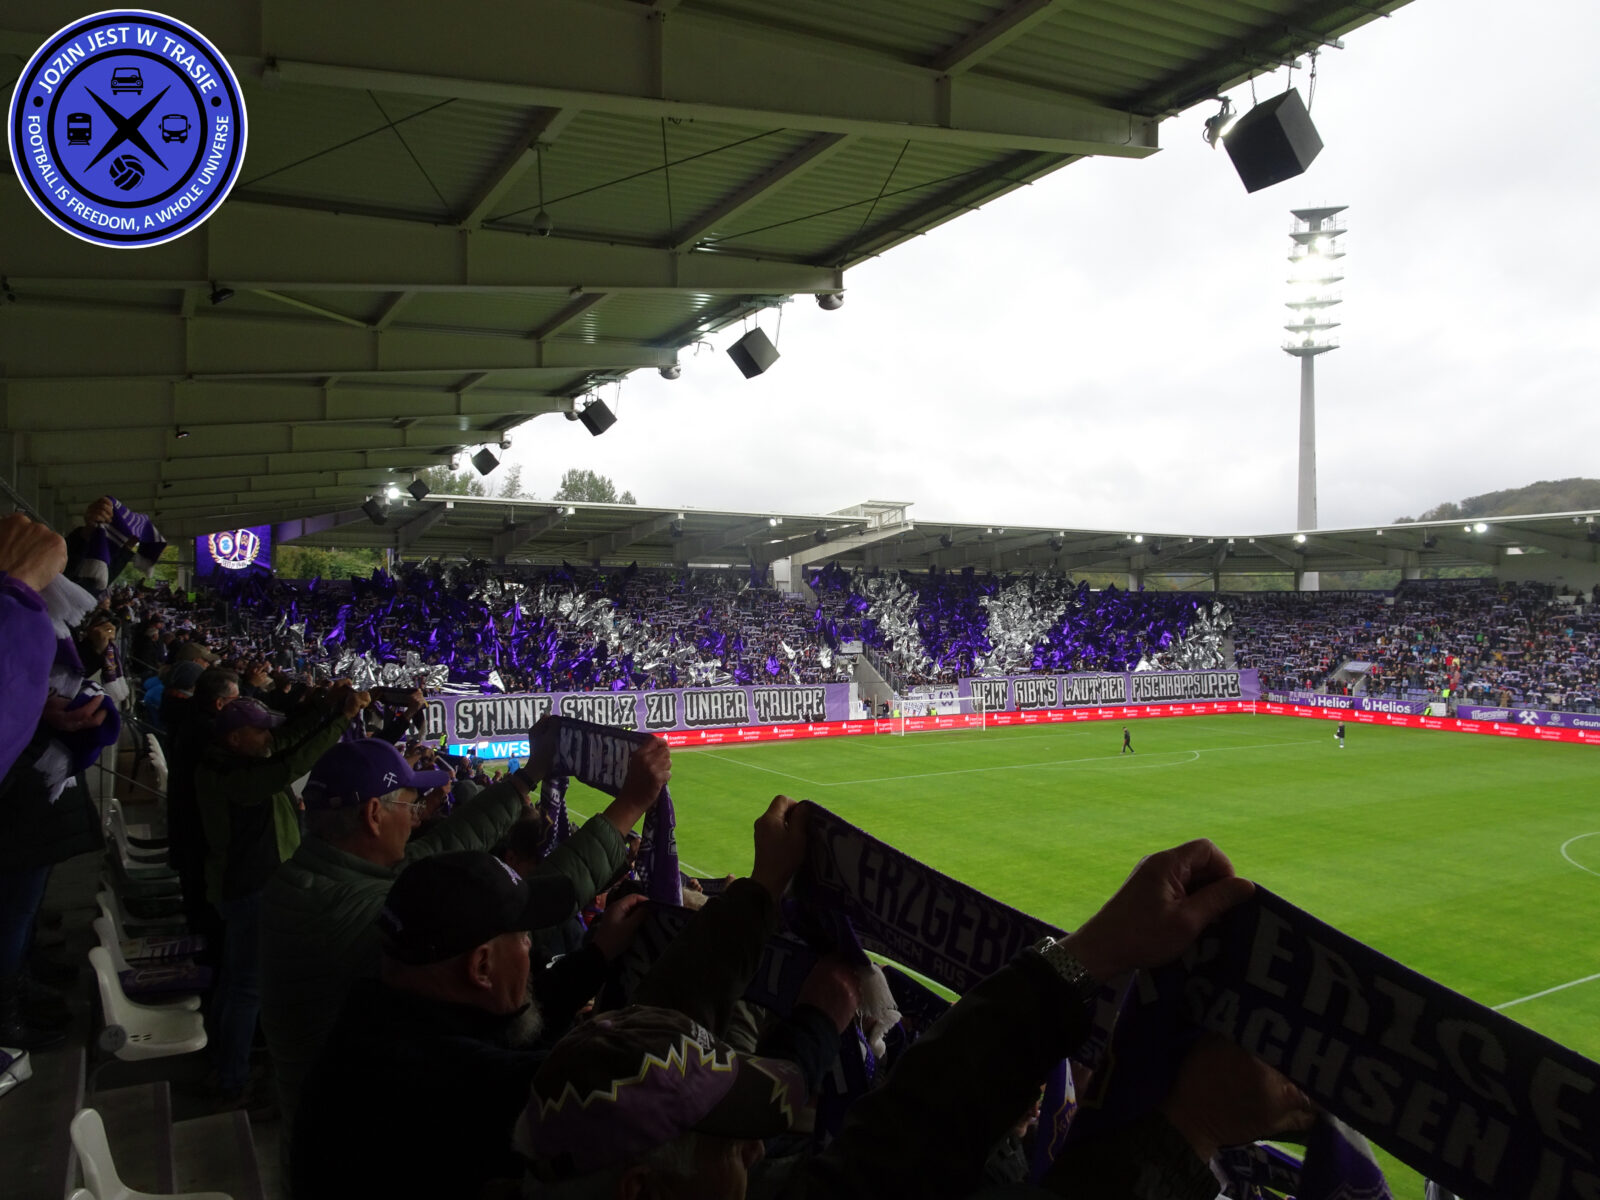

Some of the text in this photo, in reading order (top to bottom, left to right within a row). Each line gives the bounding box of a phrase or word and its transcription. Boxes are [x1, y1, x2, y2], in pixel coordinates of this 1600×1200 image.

[1015, 678, 1058, 703] GIBT'S
[646, 694, 675, 724] ZU
[755, 688, 824, 718] TRUPPE
[1318, 696, 1350, 709] Helios
[1372, 701, 1411, 714] Helios
